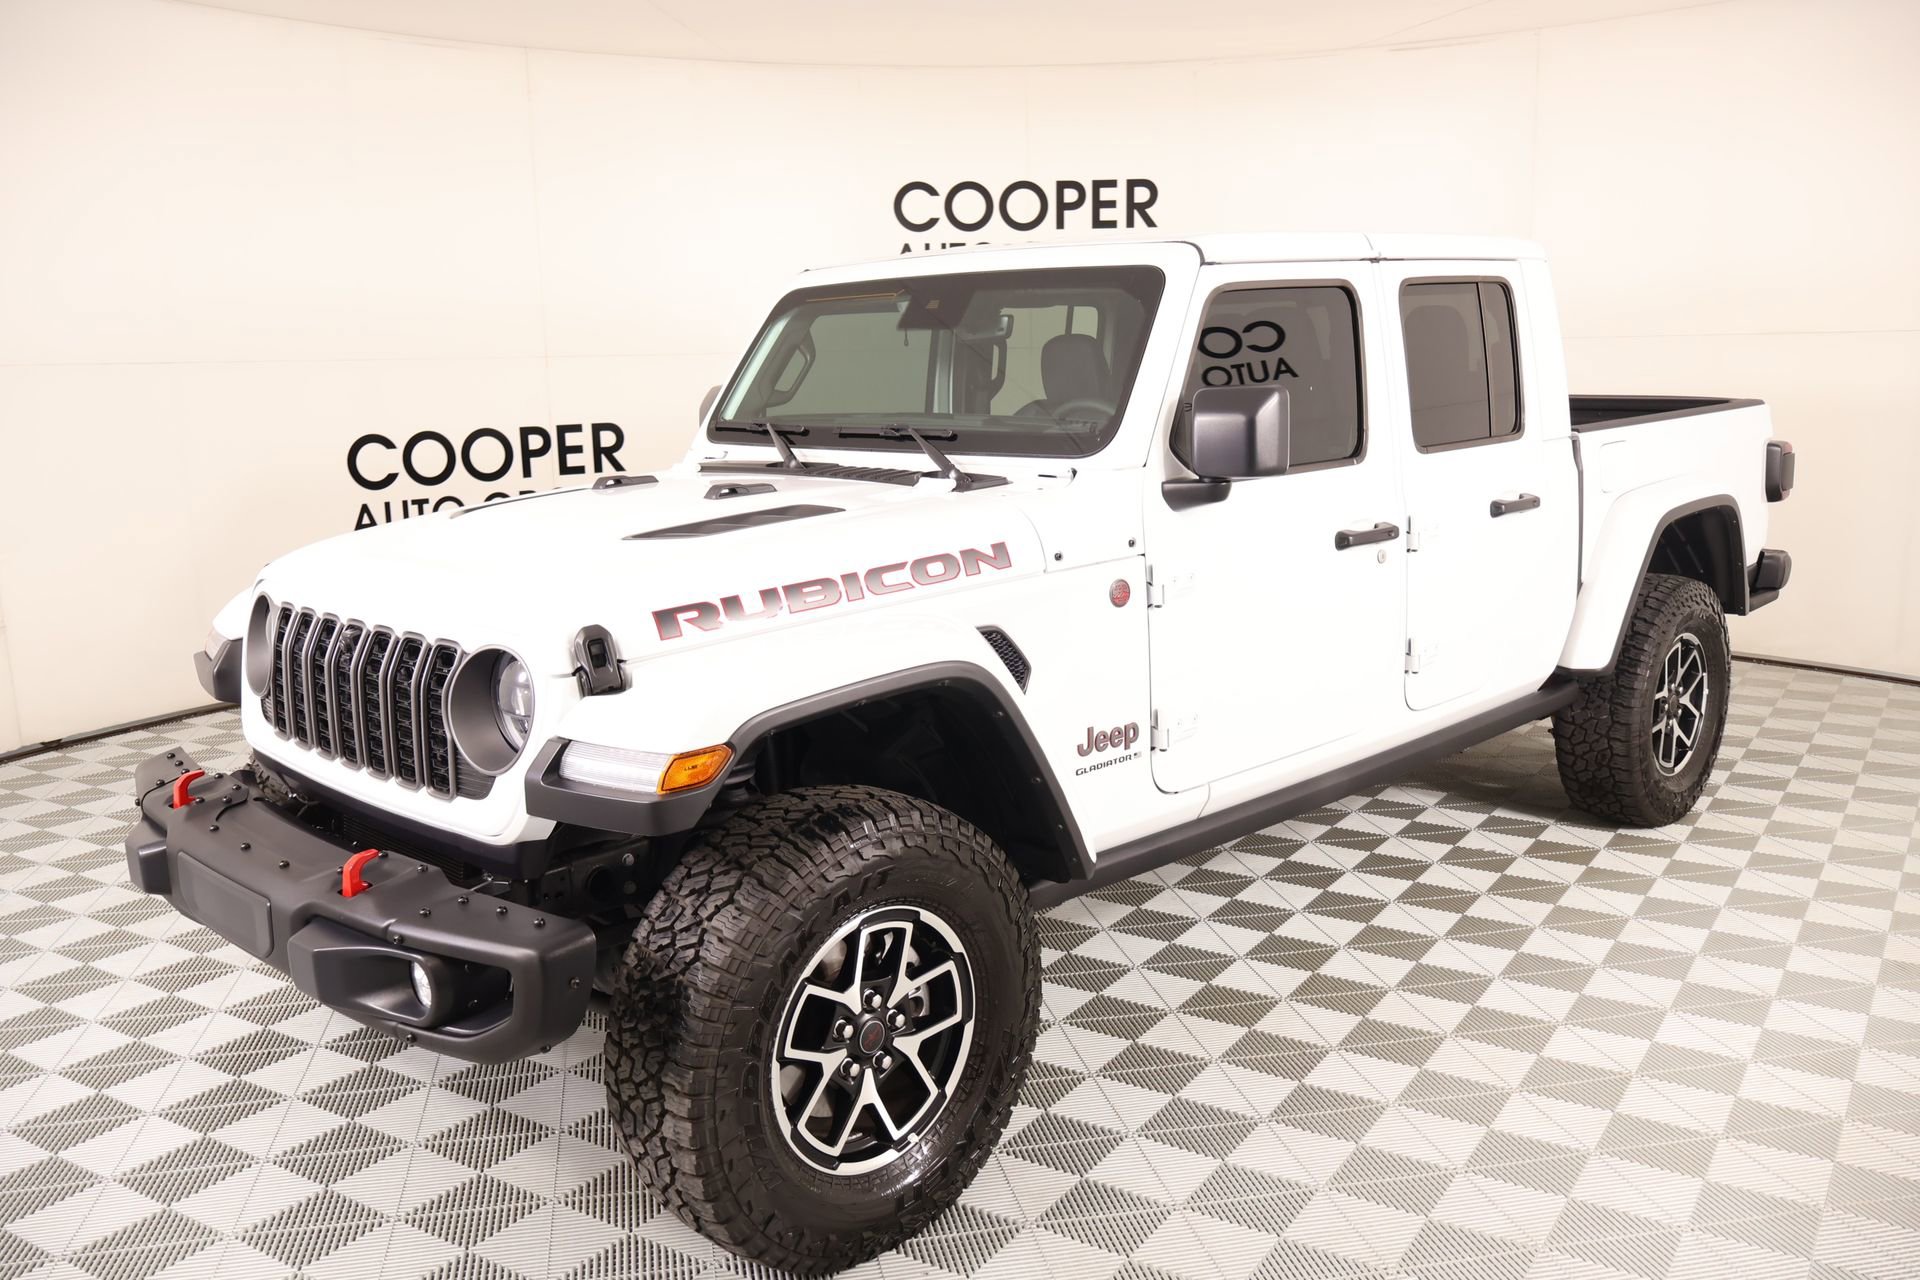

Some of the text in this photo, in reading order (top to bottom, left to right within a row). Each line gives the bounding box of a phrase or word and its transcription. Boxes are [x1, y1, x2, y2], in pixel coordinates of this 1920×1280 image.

[893, 178, 1159, 232] COOPER
[347, 422, 626, 491] COOPER
[651, 541, 1012, 641] RUBICON
[1075, 754, 1132, 776] GLADIATOR
[1076, 722, 1140, 757] Jeep
